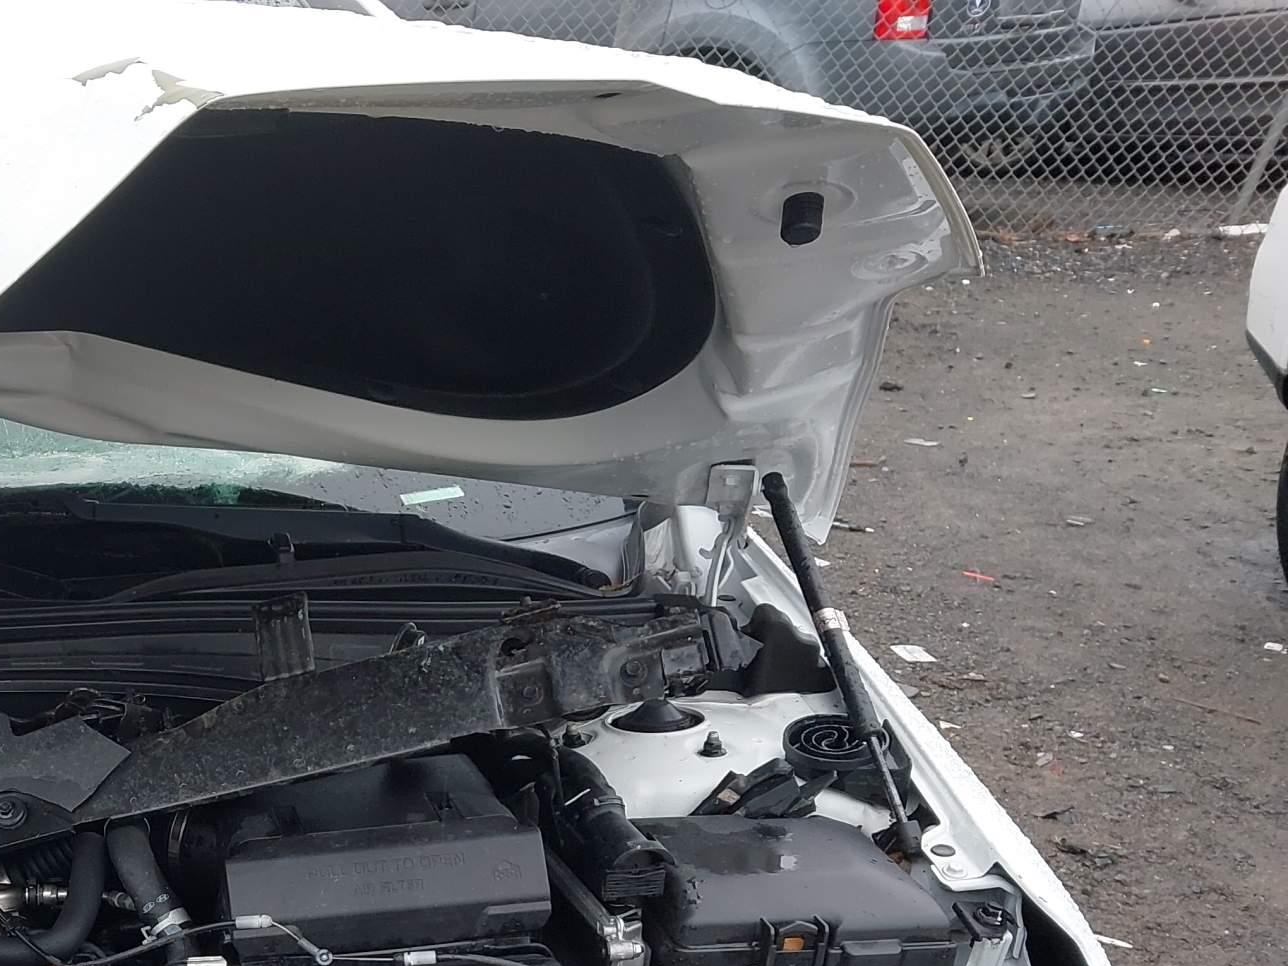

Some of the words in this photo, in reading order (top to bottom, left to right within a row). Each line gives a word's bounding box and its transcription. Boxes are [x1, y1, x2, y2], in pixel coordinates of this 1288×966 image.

[353, 859, 387, 875] OUT
[392, 856, 414, 872] TO
[419, 852, 465, 870] OPEN
[380, 877, 424, 894] FILTER
